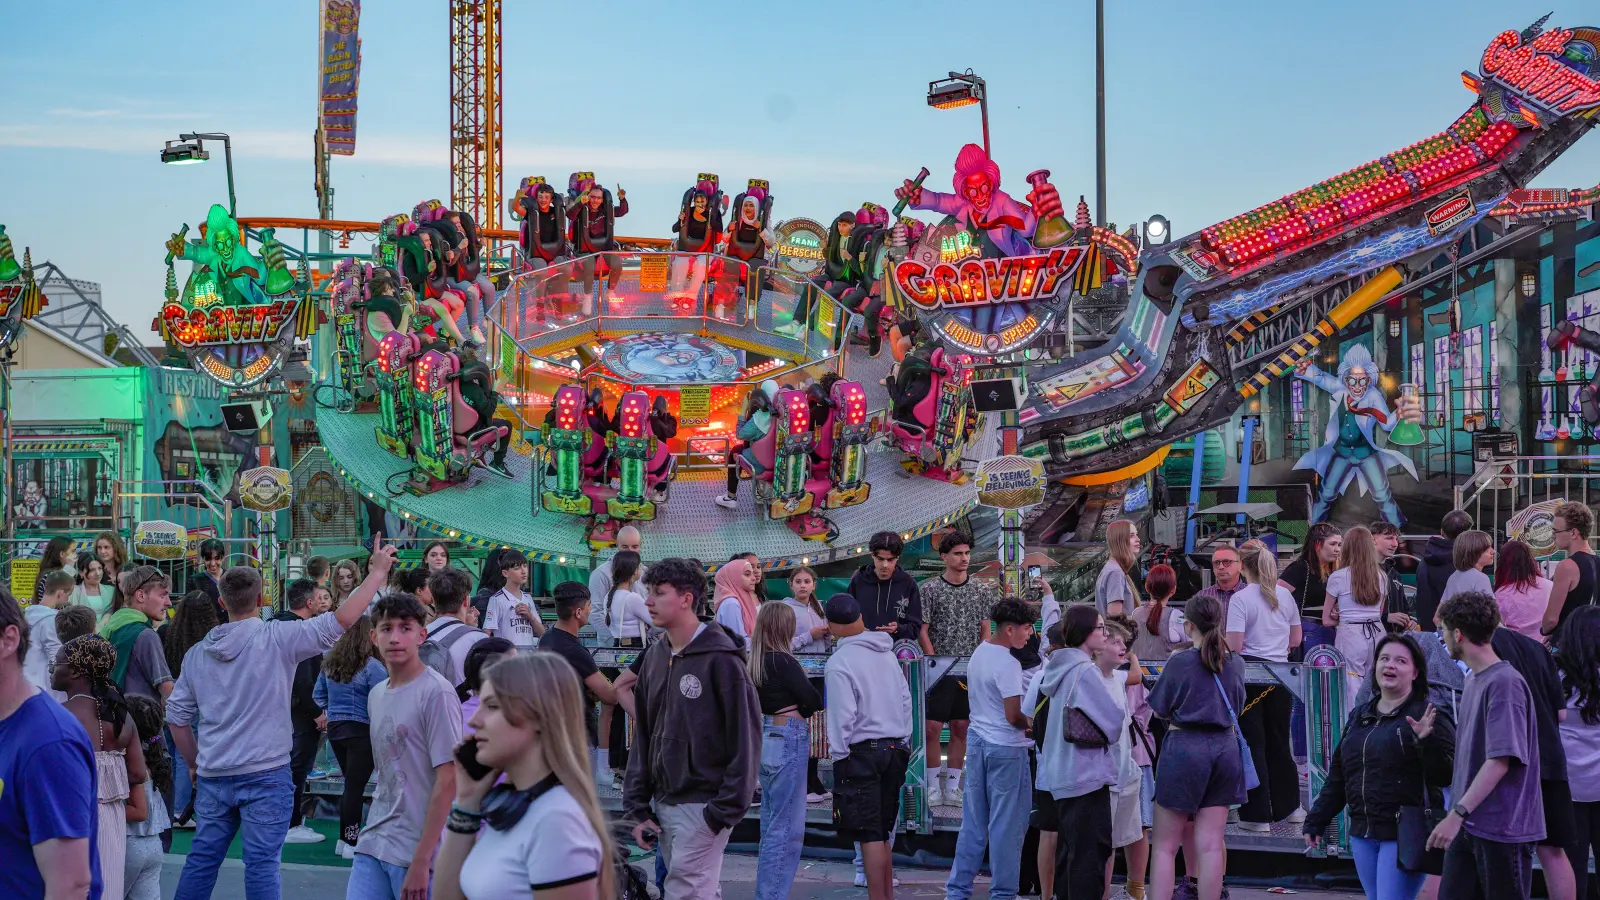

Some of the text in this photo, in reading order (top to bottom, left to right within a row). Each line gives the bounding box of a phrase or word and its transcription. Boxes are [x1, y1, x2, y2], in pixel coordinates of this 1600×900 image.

[334, 42, 345, 51] DIE
[327, 51, 351, 63] BAHN
[323, 60, 356, 75] MIT DEM
[328, 73, 353, 84] DREH!
[1431, 200, 1467, 222] WARNING
[791, 236, 819, 248] FRANK
[941, 231, 980, 262] MR.
[896, 248, 1084, 308] GRAVITY
[163, 299, 297, 347] GRAVITY
[944, 316, 1038, 347] LIQUID SPEED
[204, 355, 271, 380] LIQUID SPEED
[165, 372, 226, 400] RESTRIC
[1000, 469, 1030, 481] SEEING
[985, 477, 1038, 492] BELIEVING?
[141, 538, 181, 546] BELIEVING?
